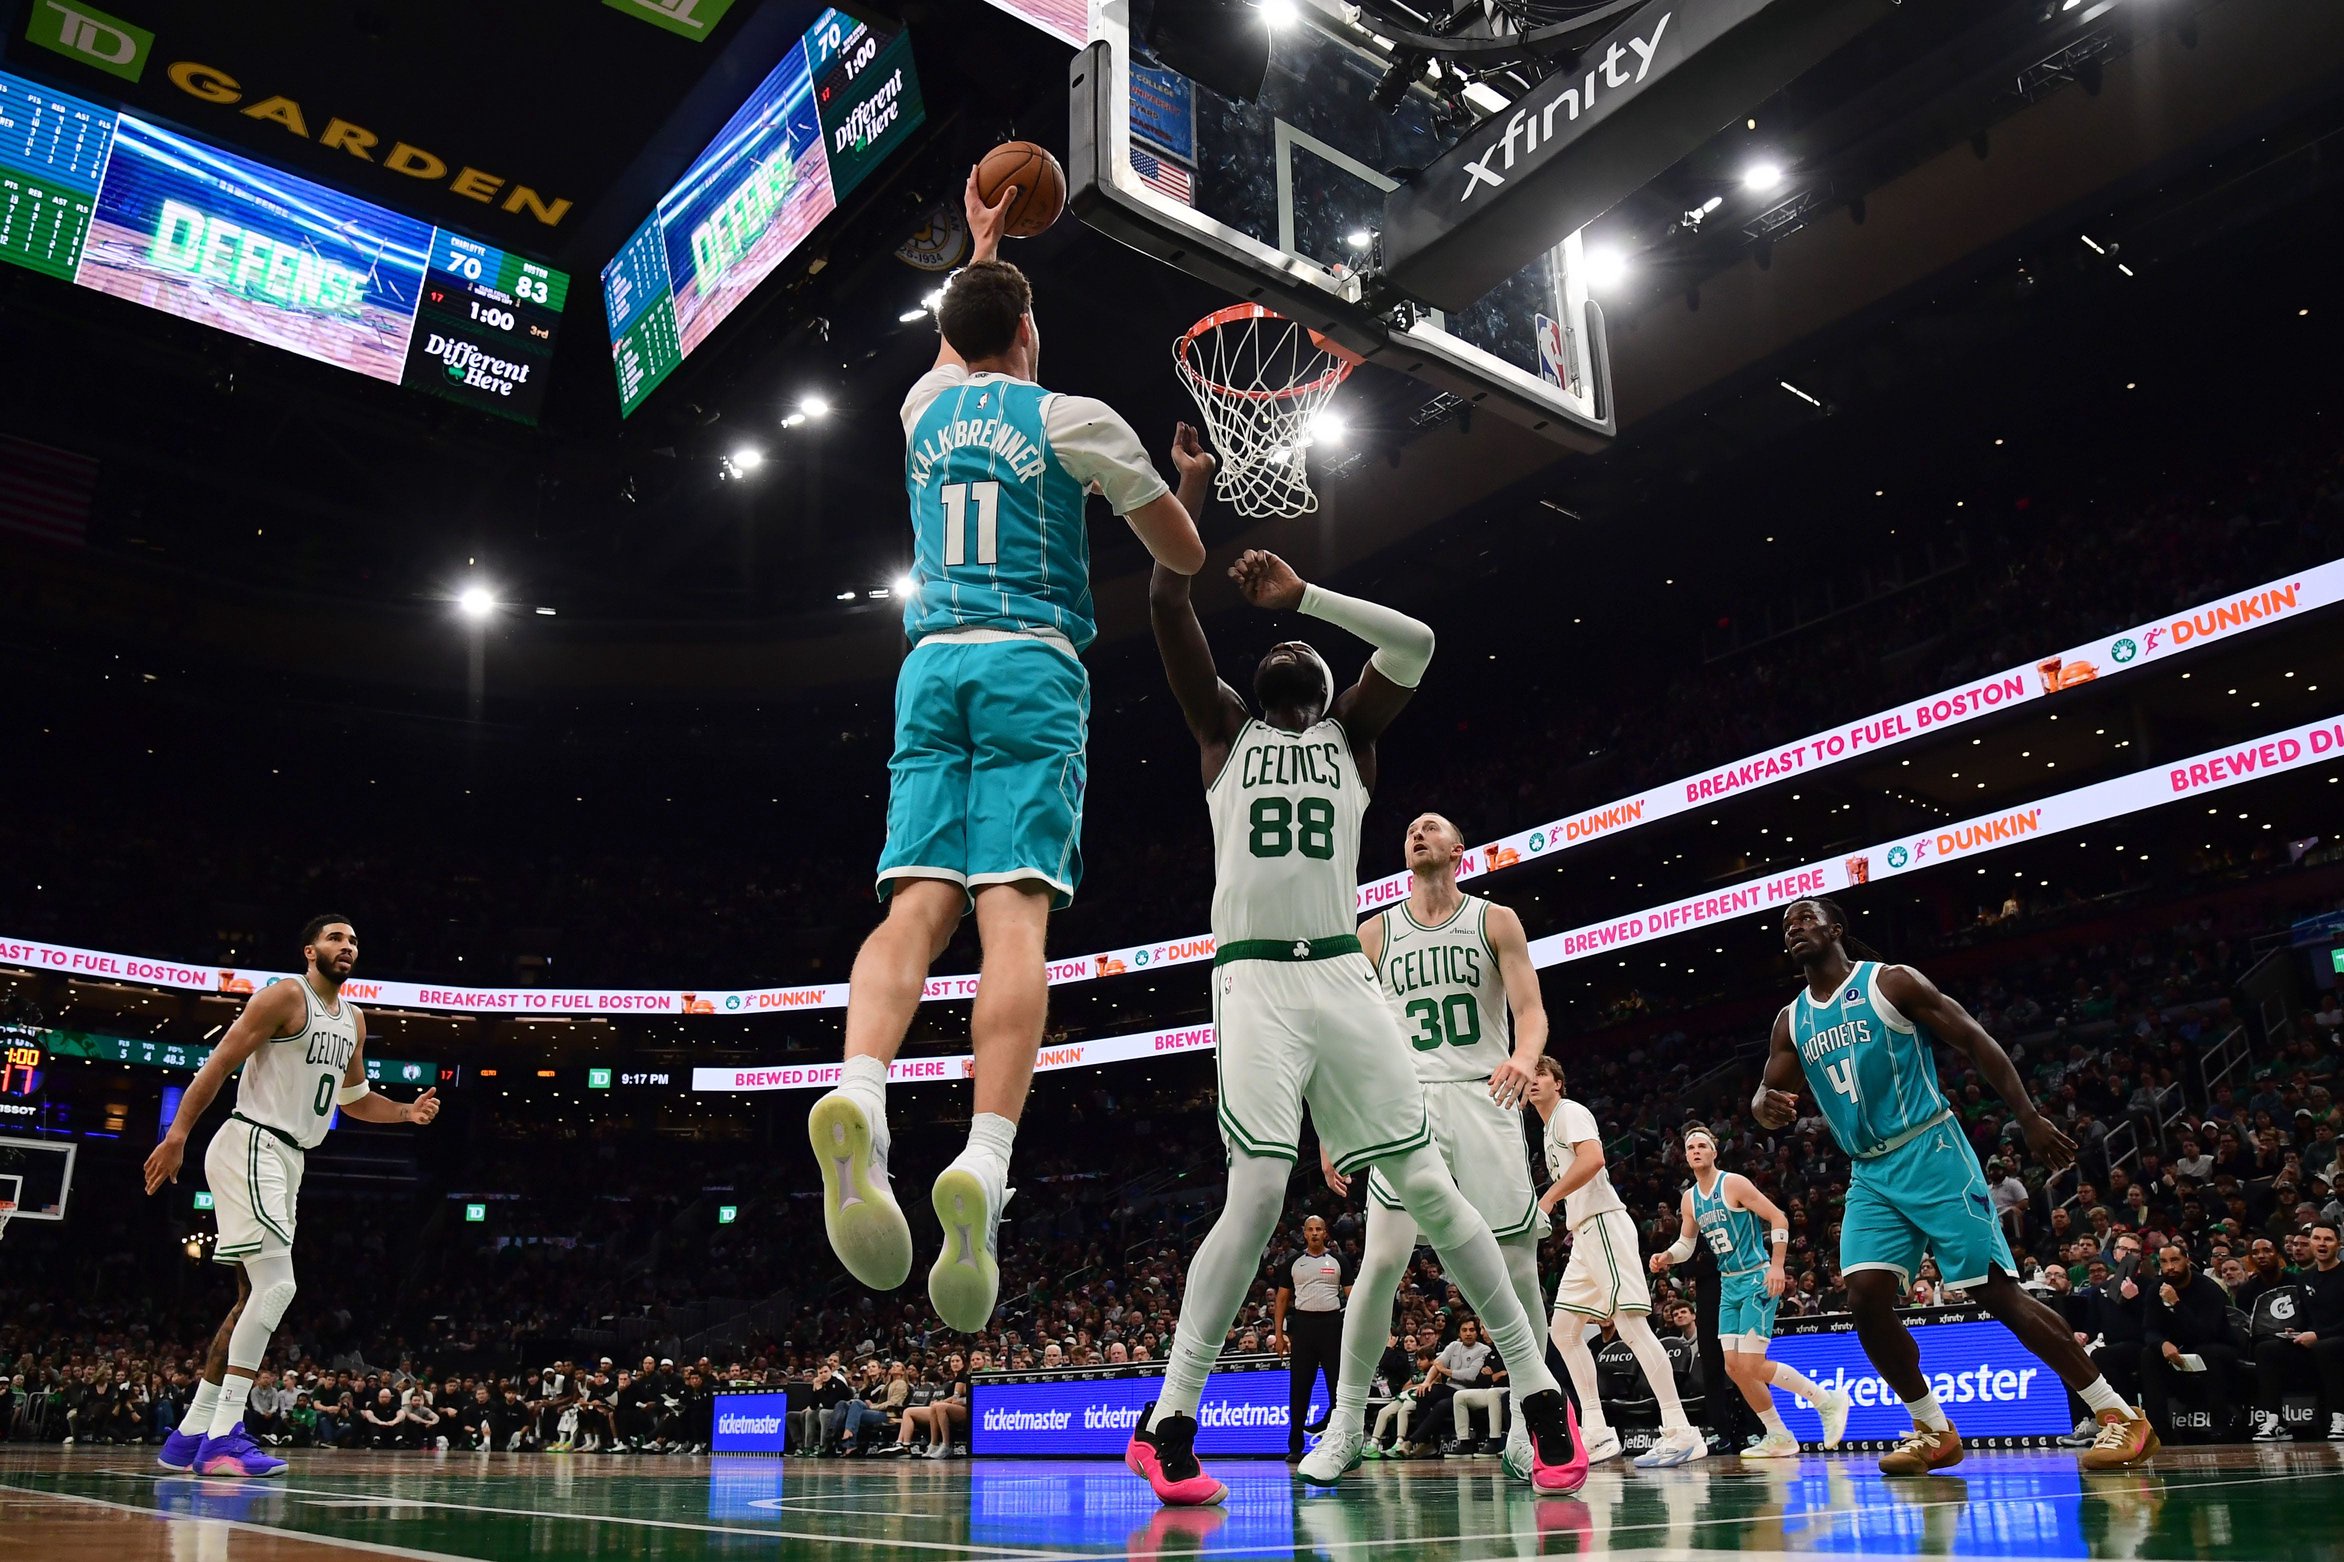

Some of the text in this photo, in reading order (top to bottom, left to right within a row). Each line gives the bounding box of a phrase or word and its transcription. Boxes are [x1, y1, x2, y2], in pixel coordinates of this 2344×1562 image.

[818, 23, 840, 62] 70
[844, 38, 876, 80] 1:00
[28, 94, 42, 104] PTS
[75, 112, 90, 122] AST
[46, 0, 573, 227] TD GARDEN
[835, 68, 902, 154] Different
[1460, 12, 1672, 202] xfinity
[866, 101, 898, 146] Here
[4, 180, 88, 214] PTS REB AST FLS
[690, 140, 797, 297] DEFENSE
[149, 199, 370, 305] DEFENSE
[447, 251, 482, 280] 70
[430, 292, 444, 302] 17
[515, 276, 548, 304] 83
[470, 302, 515, 331] 1:00
[530, 325, 549, 340] 3rd
[424, 334, 530, 384] Different
[464, 367, 513, 396] Here
[911, 418, 1047, 488] KALKBRENNER
[940, 480, 1000, 566] 11
[2171, 582, 2301, 645] DUNKIN'
[1686, 675, 2024, 803] BREAKFAST TO FUEL BOSTON
[1242, 743, 1340, 790] CELTICS
[2170, 738, 2301, 792] BREWED
[1250, 796, 1335, 861] 88
[1566, 799, 1646, 841] DUNKIN'
[1936, 808, 2043, 857] DUNKIN'
[1366, 881, 1404, 906] FUEL
[1564, 868, 1826, 955] BREWED DIFFERENT HERE
[1450, 927, 1476, 935] Amica
[1168, 938, 1215, 961] DUNK
[40, 949, 67, 966] TO
[72, 954, 120, 974] FUEL
[126, 962, 207, 986] BOSTON
[1046, 962, 1086, 982] STON
[1390, 946, 1480, 996] CELTICS
[339, 984, 382, 999] NKIN'
[420, 990, 671, 1010] BREAKFAST TO FUEL BOSTON
[759, 990, 826, 1008] DUNKIN'
[956, 979, 978, 995] TO
[1405, 992, 1482, 1051] 30
[306, 1032, 354, 1074] CELTICS
[1154, 1028, 1216, 1051] BREWE
[1801, 1020, 1872, 1066] HORNETS
[8, 1048, 40, 1066] 1:00
[120, 1049, 128, 1059] 5
[144, 1052, 152, 1062] 4
[162, 1054, 186, 1066] 48.5
[1035, 1047, 1085, 1068] UNKIN'
[2, 1064, 34, 1095] 17
[366, 1069, 380, 1080] 36
[440, 1070, 453, 1080] 17
[592, 1071, 607, 1085] TD
[621, 1074, 669, 1085] 9:17 PM
[735, 1062, 946, 1086] BREWED HERE
[1826, 1057, 1858, 1104] 4
[313, 1072, 336, 1116] 0
[0, 1104, 36, 1116] ISSOT
[198, 1194, 213, 1206] TD
[468, 1206, 484, 1218] TD
[721, 1209, 736, 1220] TD
[1796, 1312, 1964, 1334] xfinity xfinity xfinity xfinity
[1598, 1352, 1633, 1363] PIMCO
[718, 1412, 781, 1435] ticketmaster
[983, 1408, 1072, 1431] ticketmaster
[1084, 1403, 1142, 1429] ticketm
[2172, 1412, 2211, 1430] jetBl
[1623, 1434, 1659, 1451] jetBlu
